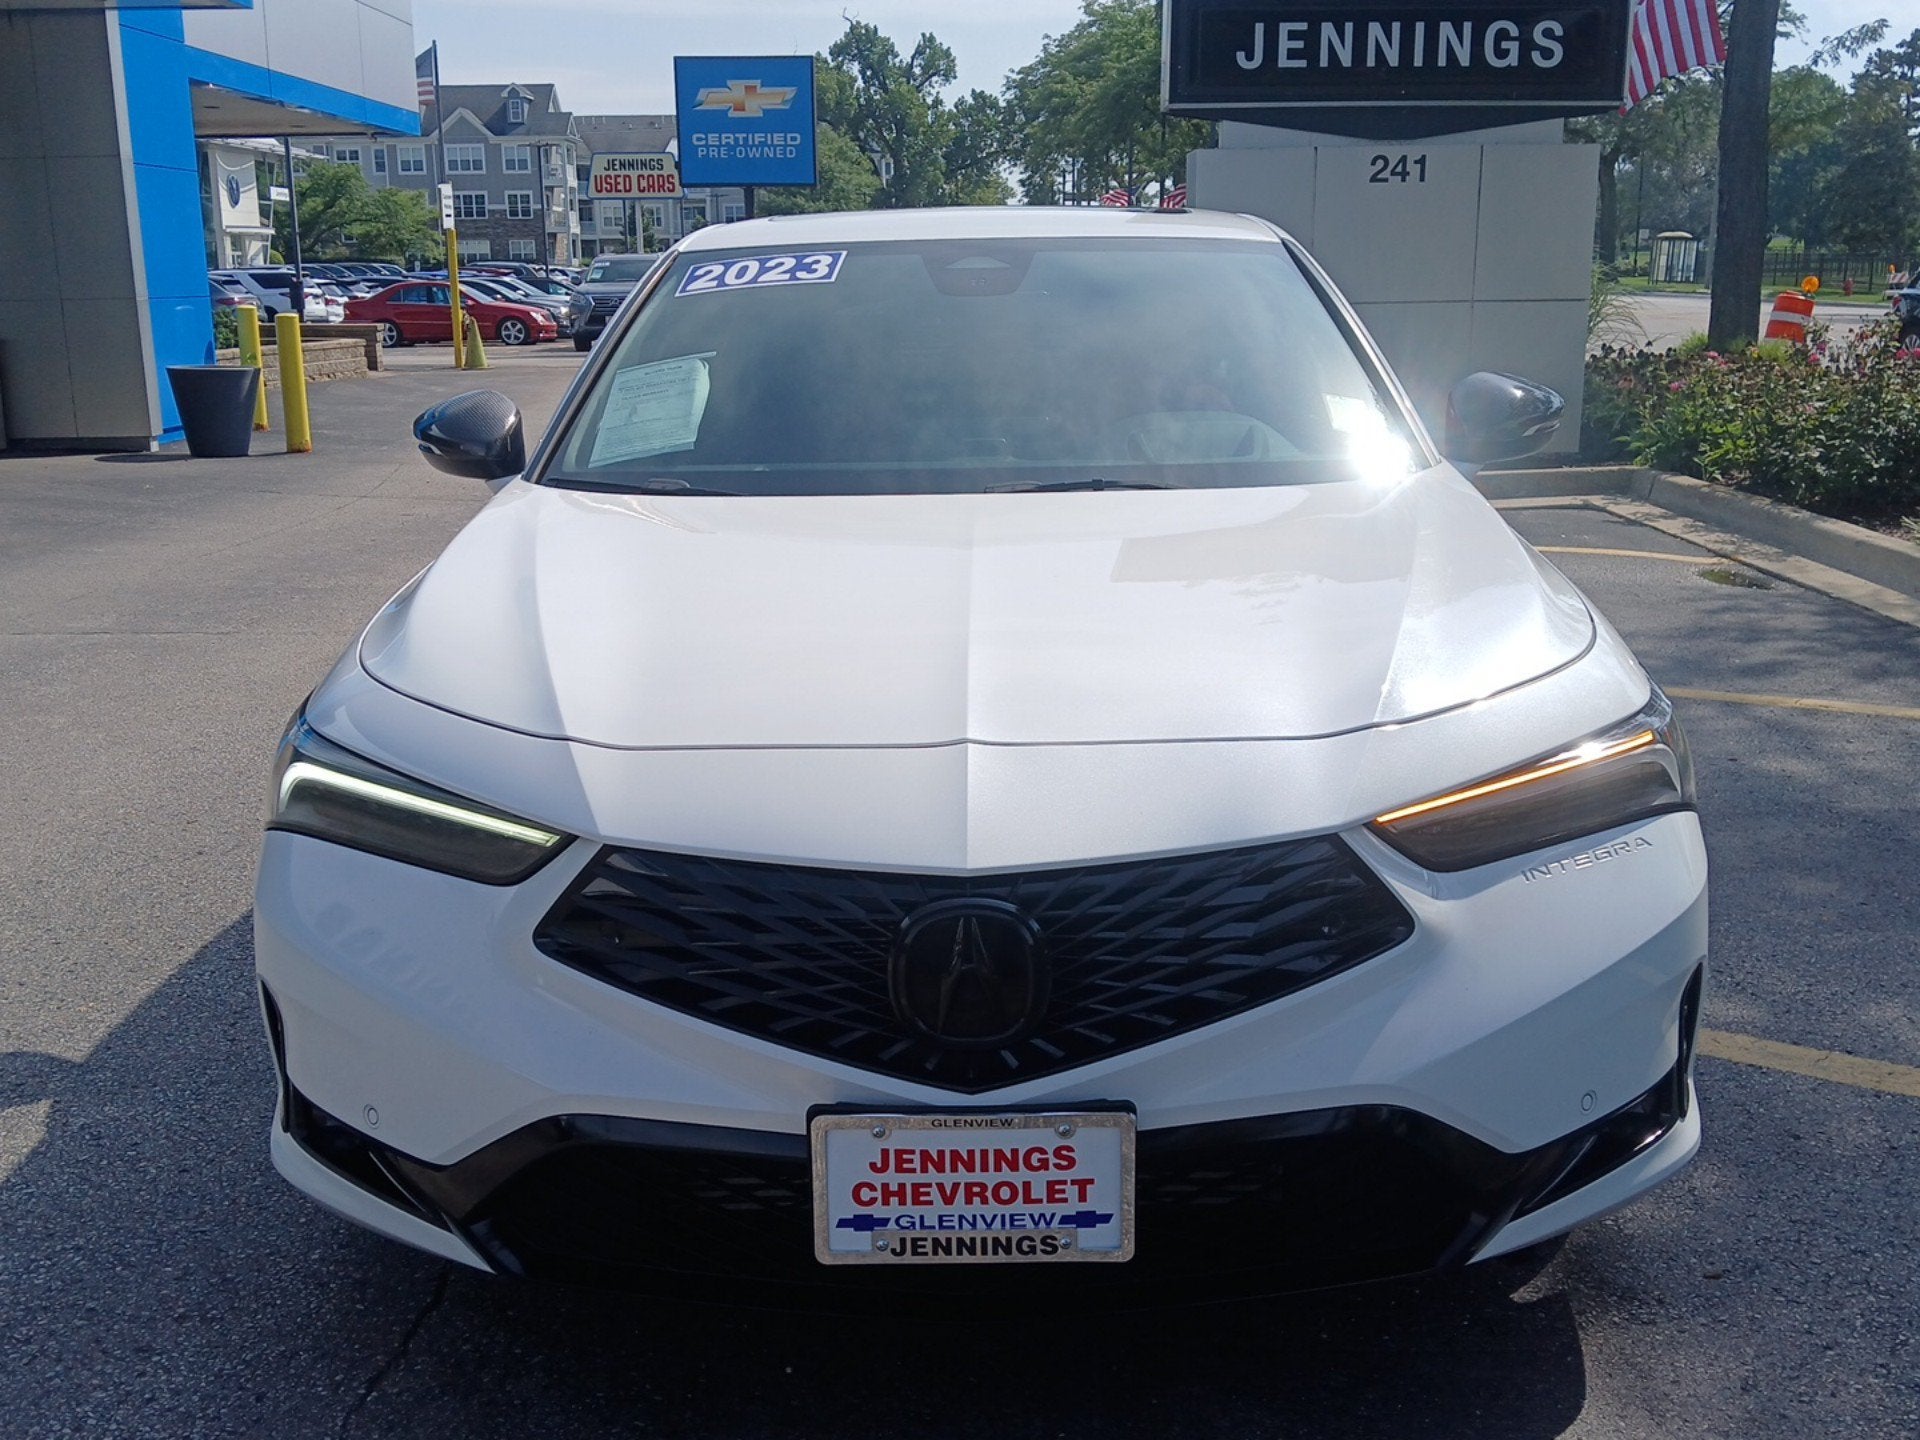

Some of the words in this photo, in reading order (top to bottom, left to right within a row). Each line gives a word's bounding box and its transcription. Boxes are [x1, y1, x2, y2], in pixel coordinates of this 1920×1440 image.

[1236, 20, 1564, 70] JENNINGS
[691, 132, 801, 146] CERTIFIED
[698, 146, 797, 158] PRE-OWNED
[603, 158, 665, 172] JENNINGS
[1369, 154, 1428, 184] 241
[594, 174, 633, 193] USED
[637, 174, 676, 193] CARS
[685, 254, 834, 291] 2023
[1520, 836, 1653, 883] INTEGRA
[931, 1117, 1015, 1128] GLENVIEW
[868, 1144, 1077, 1175] JENNINGS
[851, 1178, 1096, 1208] CHEVROLET
[894, 1211, 1057, 1231] GLENVIEW
[890, 1235, 1060, 1258] JENNINGS
